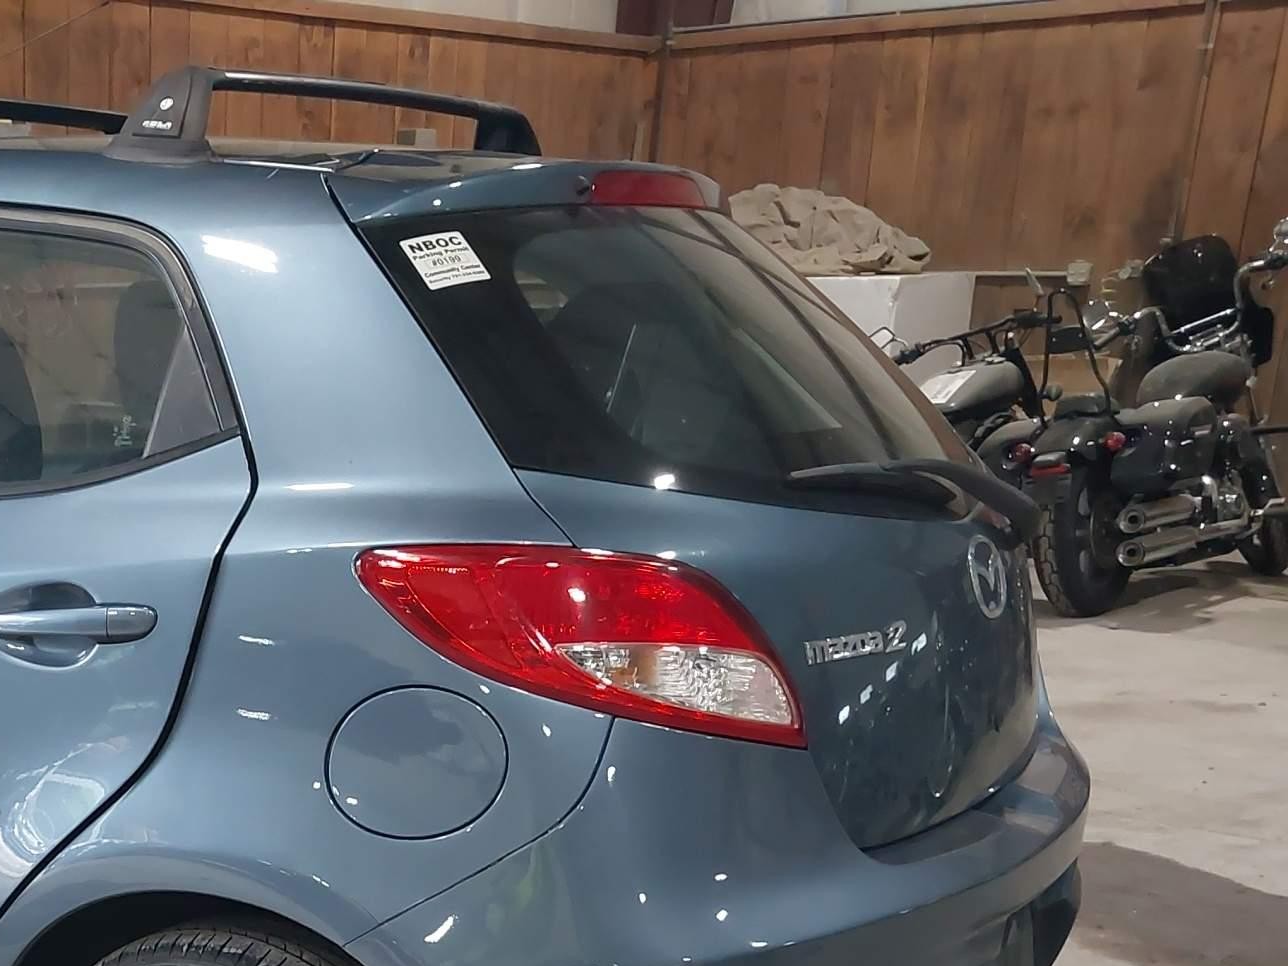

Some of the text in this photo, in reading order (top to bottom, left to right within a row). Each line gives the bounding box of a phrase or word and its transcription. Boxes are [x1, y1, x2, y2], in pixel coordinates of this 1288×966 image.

[408, 237, 462, 253] NBOC
[412, 251, 443, 261] Parking
[424, 266, 459, 278] Community
